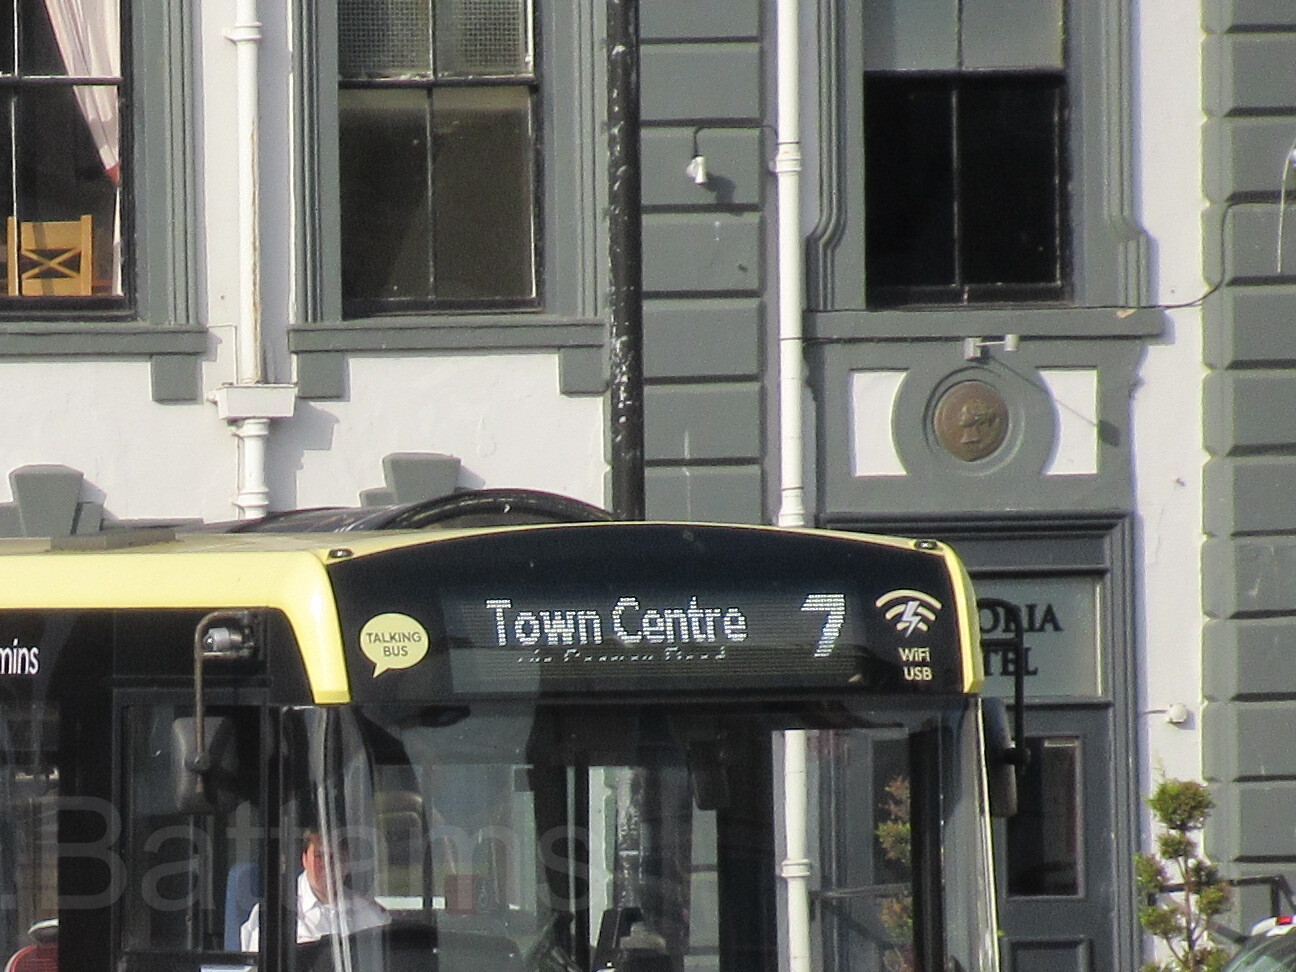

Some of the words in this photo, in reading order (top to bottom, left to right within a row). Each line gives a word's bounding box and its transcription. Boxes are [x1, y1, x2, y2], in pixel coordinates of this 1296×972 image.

[486, 598, 602, 647] Town
[612, 596, 747, 643] Centre
[801, 592, 845, 657] 7
[366, 631, 422, 644] TALKING
[383, 645, 409, 657] BUS
[899, 647, 931, 662] WiFi
[903, 666, 933, 681] USB
